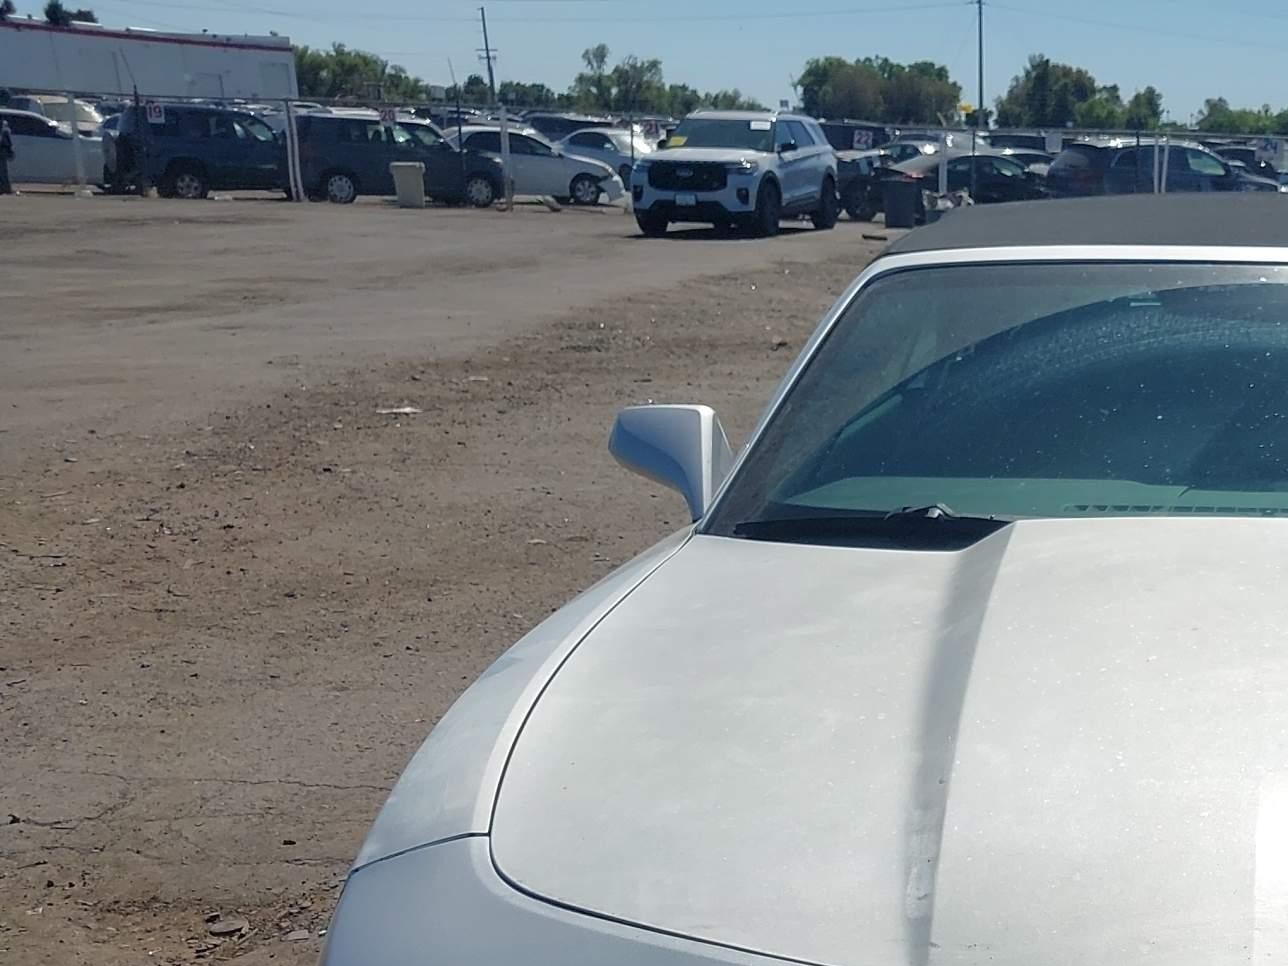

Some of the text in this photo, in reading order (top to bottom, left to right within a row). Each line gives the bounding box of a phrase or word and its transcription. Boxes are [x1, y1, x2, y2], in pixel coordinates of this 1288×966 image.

[147, 103, 162, 119] 19
[380, 110, 396, 121] 20
[856, 131, 871, 145] 22
